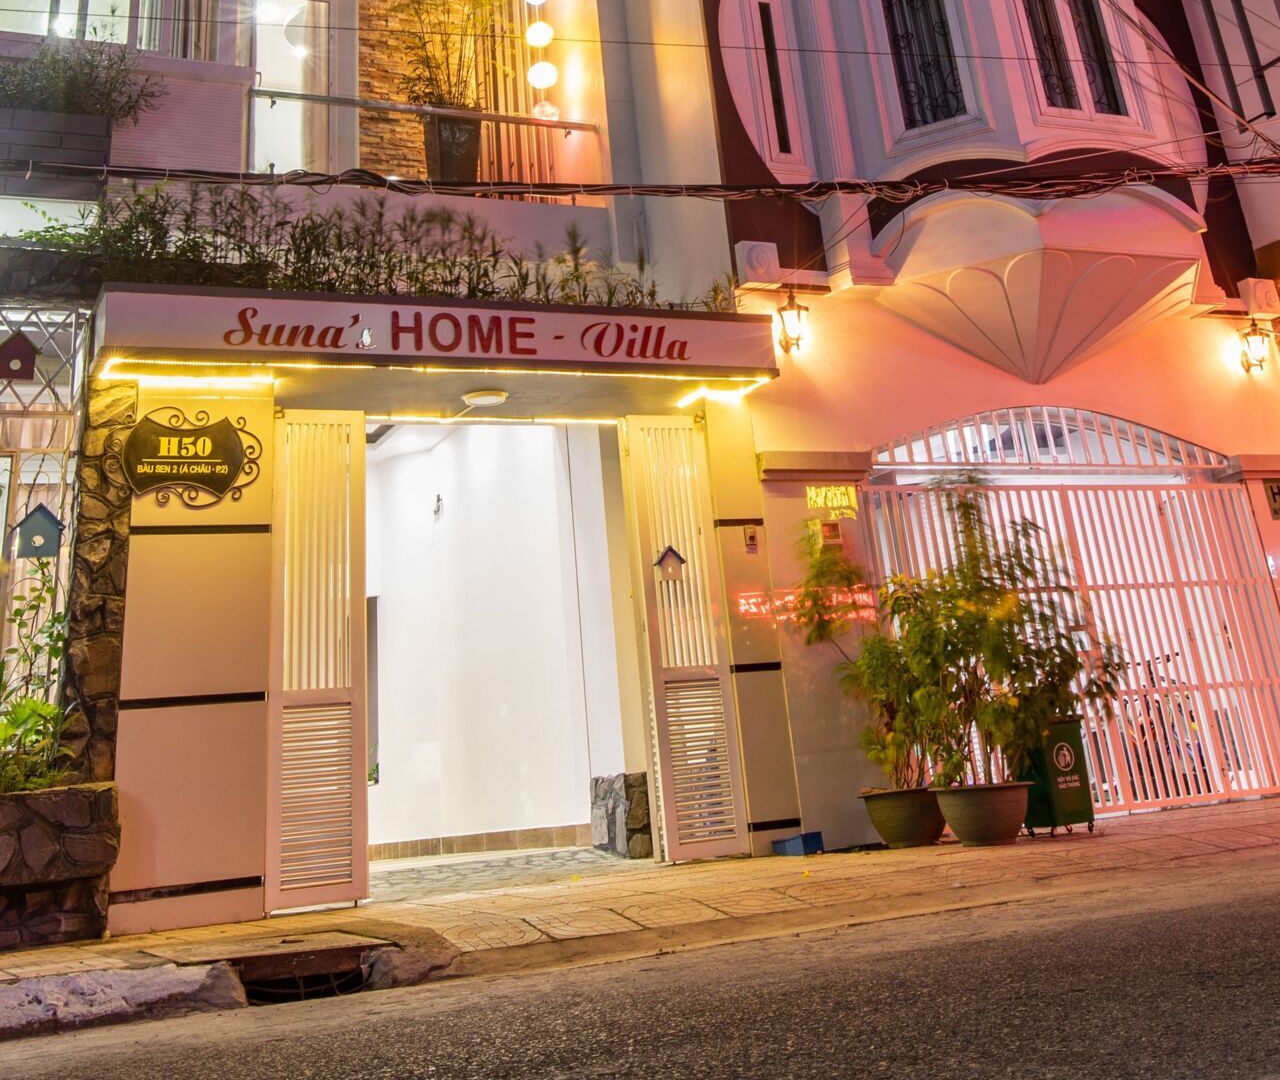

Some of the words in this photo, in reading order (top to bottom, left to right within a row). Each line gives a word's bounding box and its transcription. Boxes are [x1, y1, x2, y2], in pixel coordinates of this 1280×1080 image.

[391, 310, 538, 355] HOME
[581, 322, 693, 361] Villa
[157, 436, 213, 457] H50
[155, 465, 170, 473] SEN
[172, 465, 177, 473] 2
